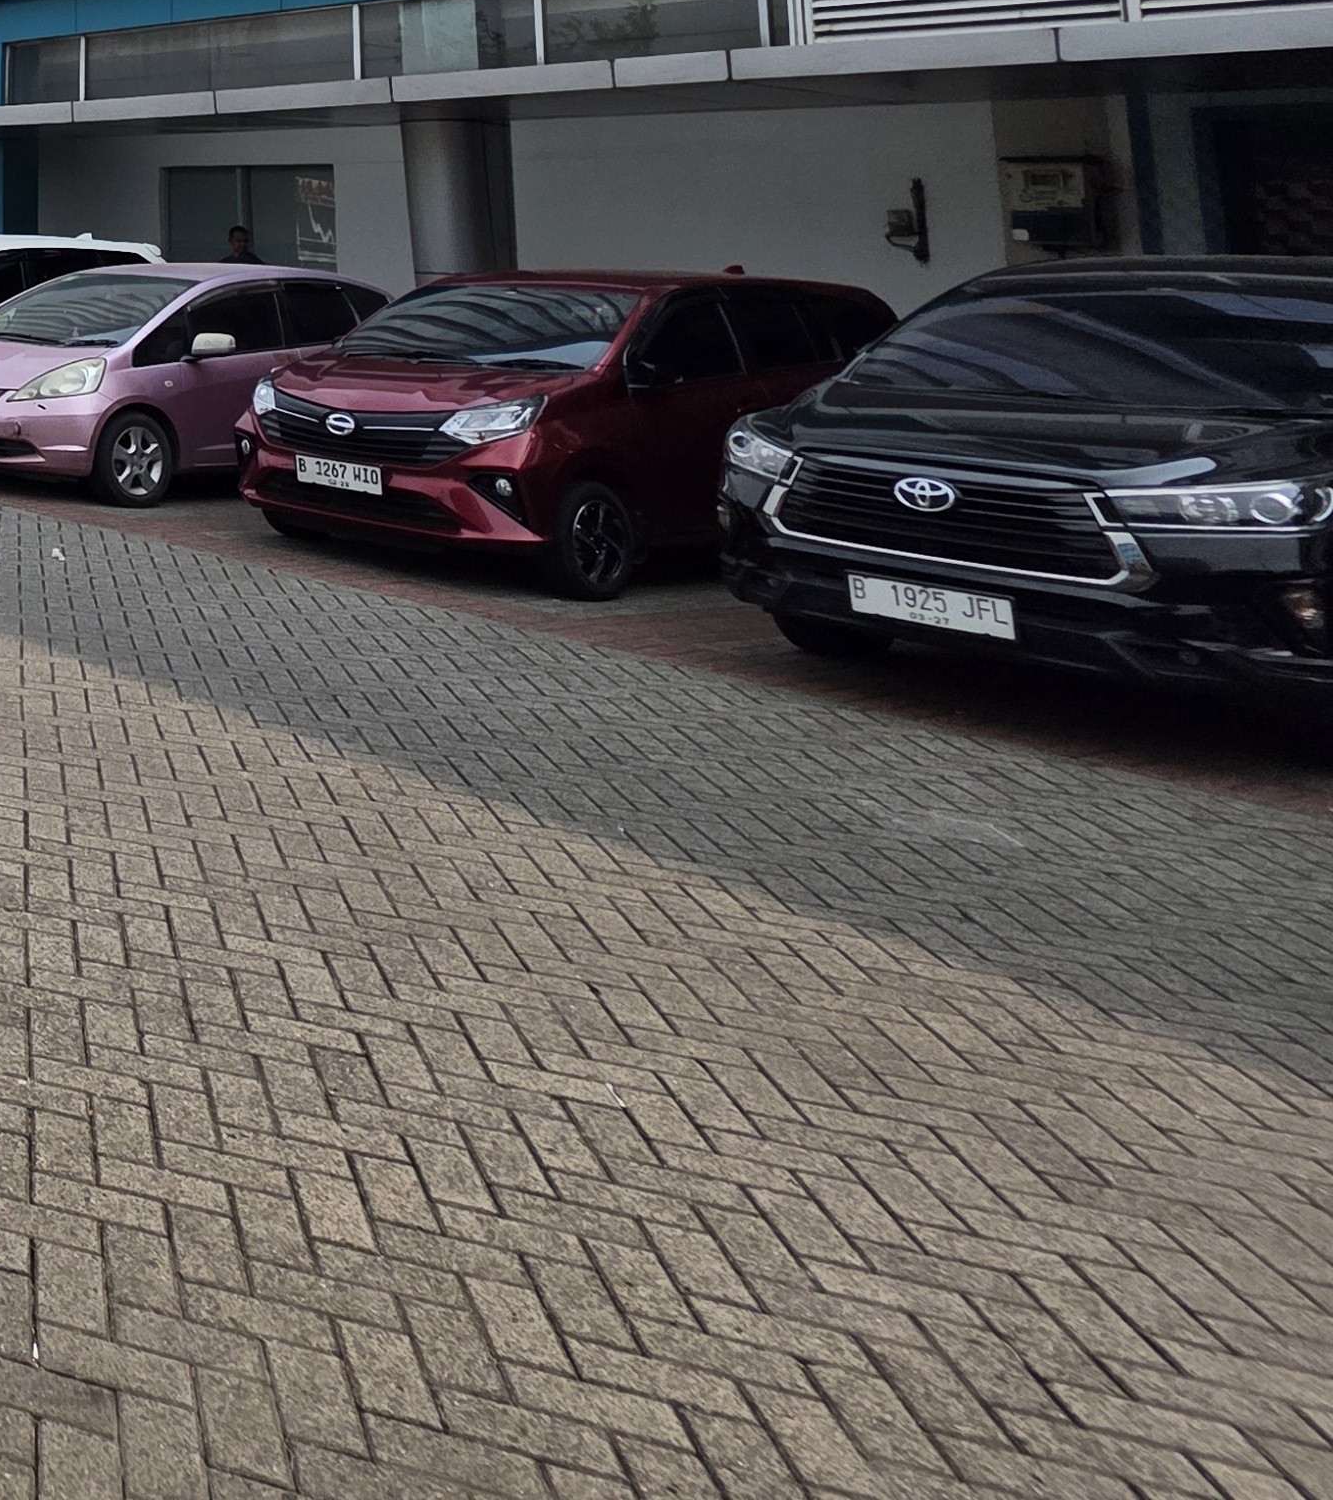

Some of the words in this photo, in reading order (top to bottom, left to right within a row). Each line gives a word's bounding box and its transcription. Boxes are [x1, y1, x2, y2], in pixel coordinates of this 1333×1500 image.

[298, 457, 307, 473] B
[315, 460, 347, 479] 1267
[852, 577, 866, 600] B
[890, 584, 948, 614] 1925
[962, 596, 1009, 626] JFL
